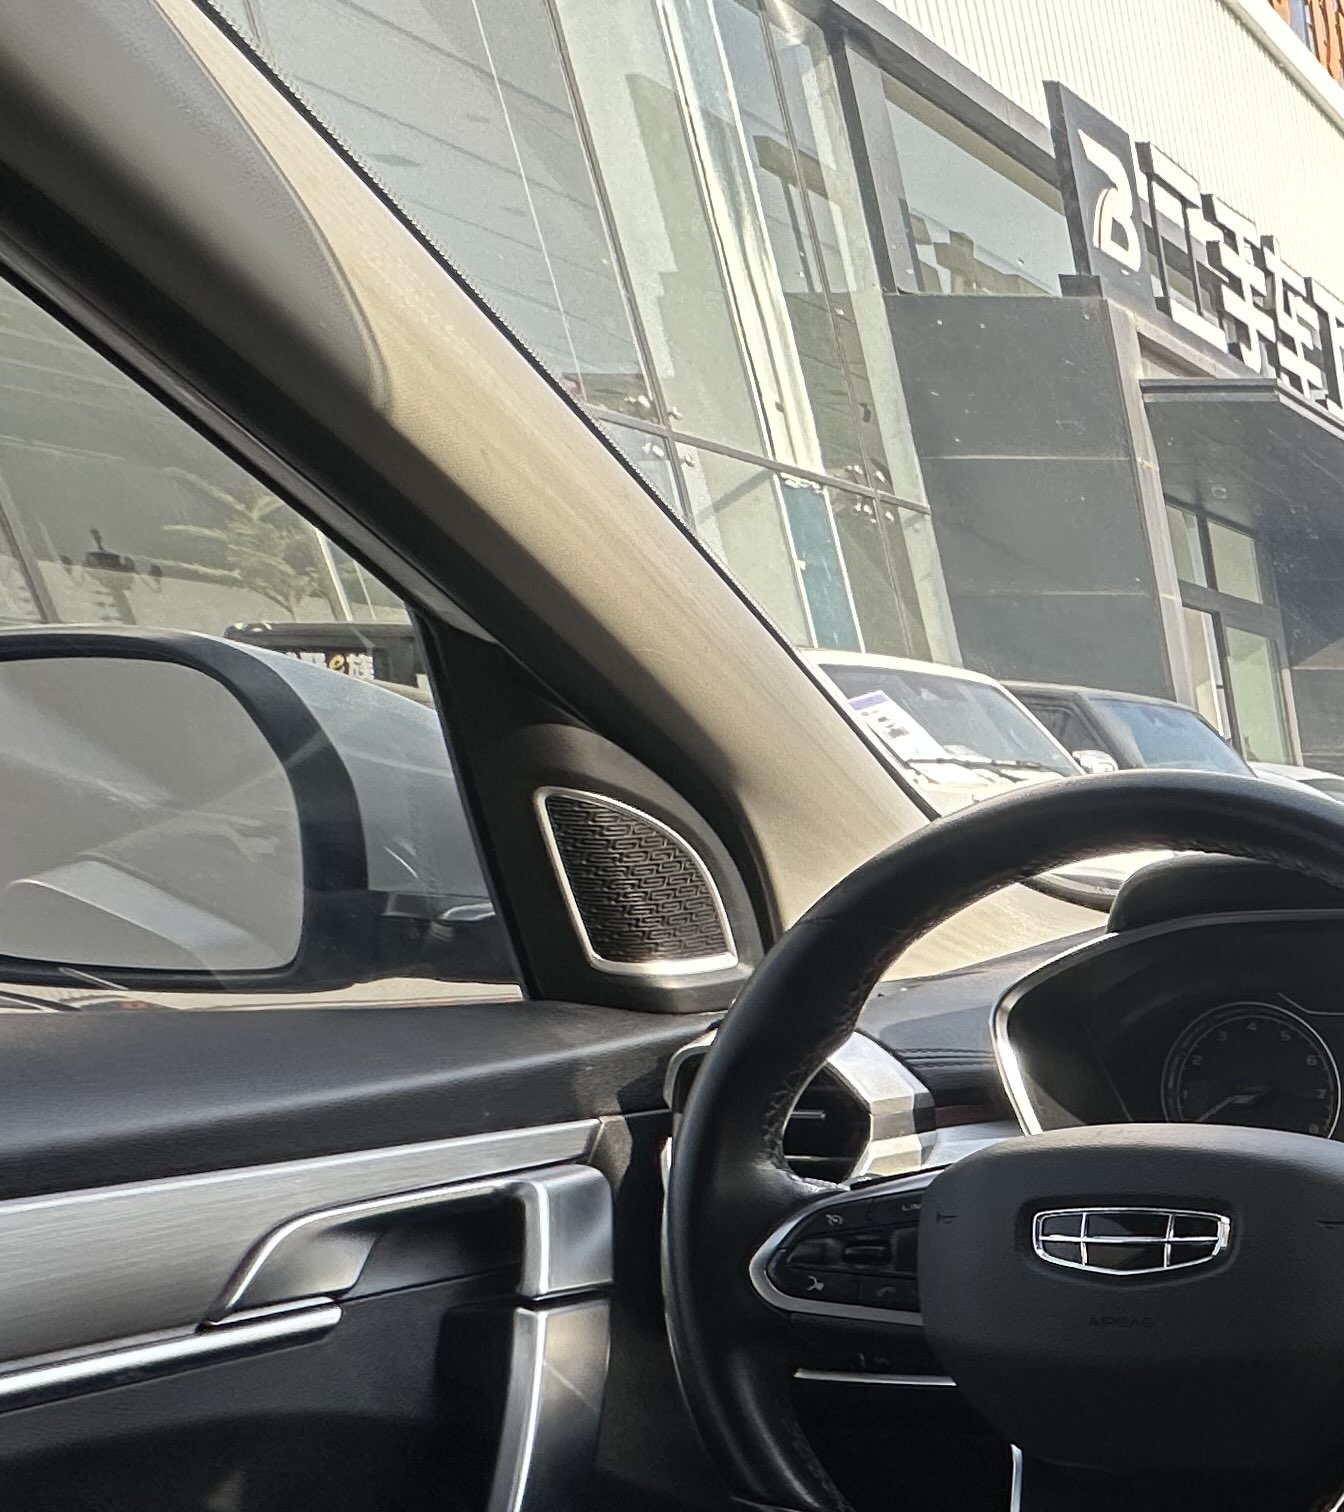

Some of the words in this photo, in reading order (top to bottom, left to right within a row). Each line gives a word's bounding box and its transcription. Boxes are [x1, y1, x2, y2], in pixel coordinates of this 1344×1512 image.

[1246, 1021, 1258, 1032] 4
[1218, 1030, 1228, 1041] 3
[1279, 1030, 1291, 1041] 5
[1192, 1054, 1204, 1066] 2
[1306, 1054, 1318, 1066] 6
